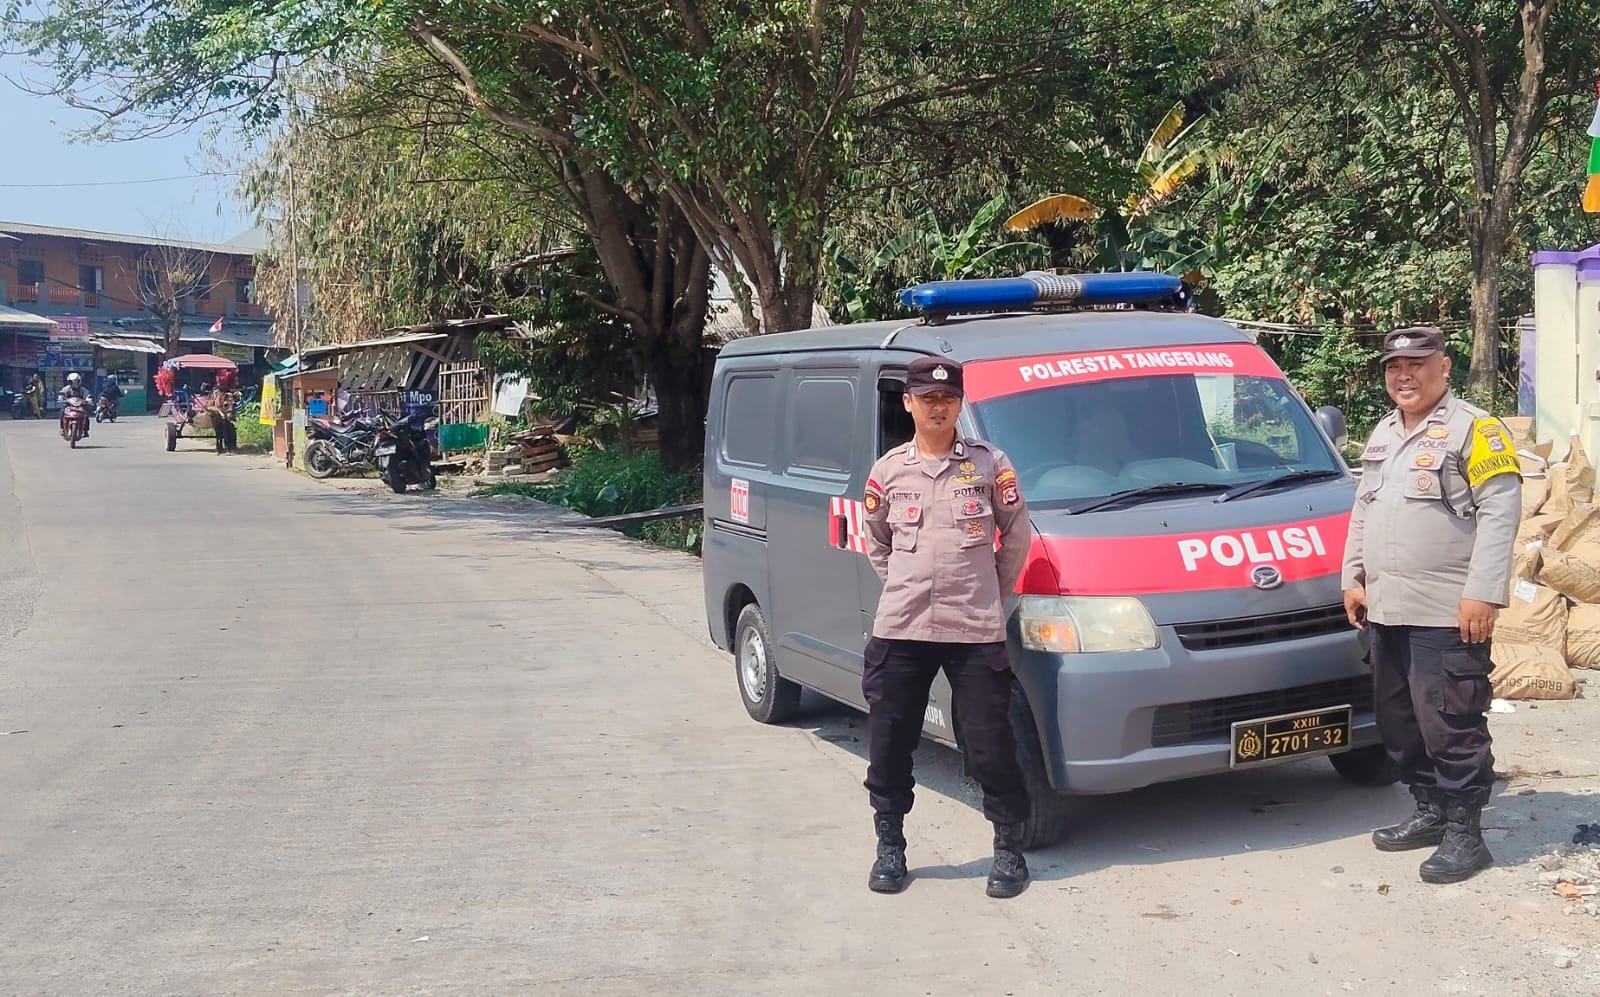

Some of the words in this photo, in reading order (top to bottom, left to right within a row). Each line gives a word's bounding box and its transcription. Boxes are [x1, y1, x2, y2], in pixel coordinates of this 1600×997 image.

[1018, 354, 1124, 382] POLRESTA
[1122, 351, 1235, 369] TANGERANG
[410, 390, 432, 405] Mpo
[1417, 440, 1449, 449] POLRI
[954, 486, 985, 498] POLRI
[1177, 525, 1326, 572] POLISI
[1526, 679, 1562, 691] BRIGHT
[1292, 716, 1320, 730] XXIII
